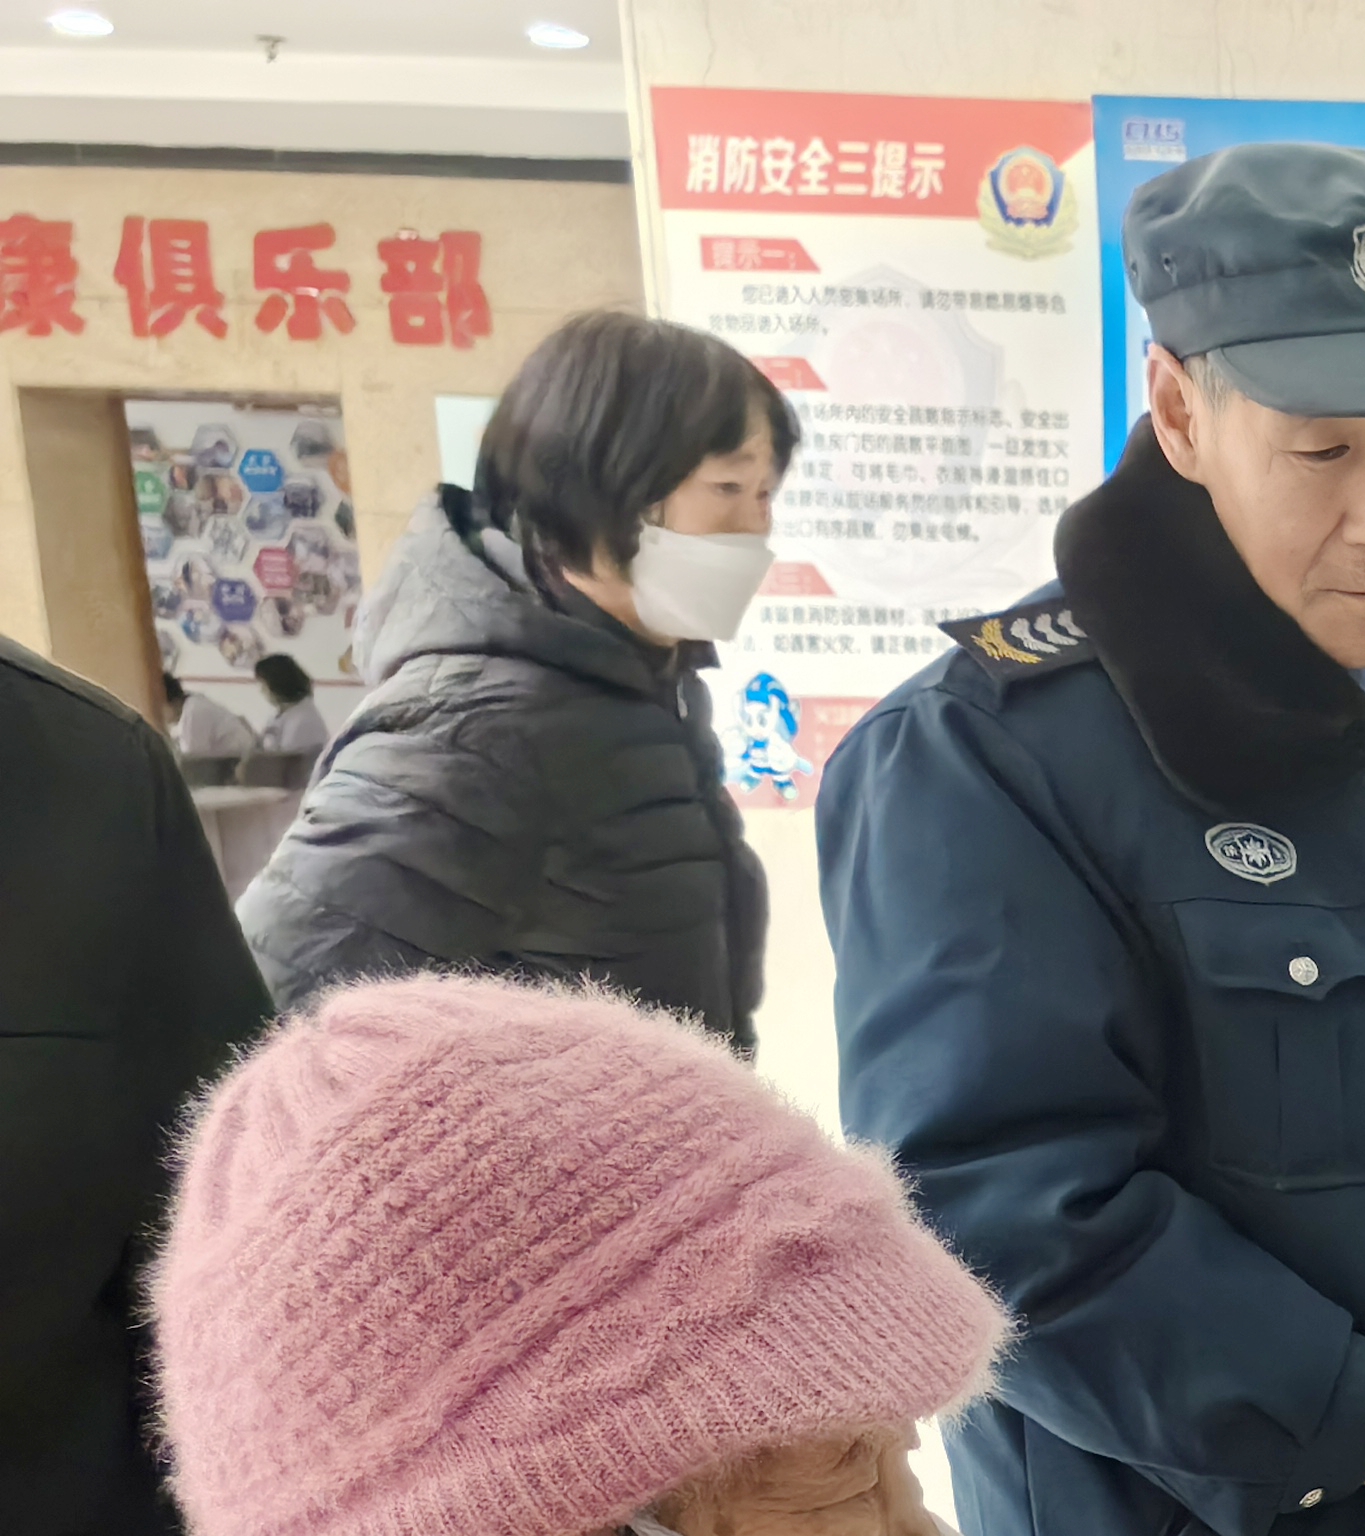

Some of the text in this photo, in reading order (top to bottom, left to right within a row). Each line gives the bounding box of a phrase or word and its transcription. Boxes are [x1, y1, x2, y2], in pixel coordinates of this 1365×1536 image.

[687, 134, 945, 200] 消防安全三提示
